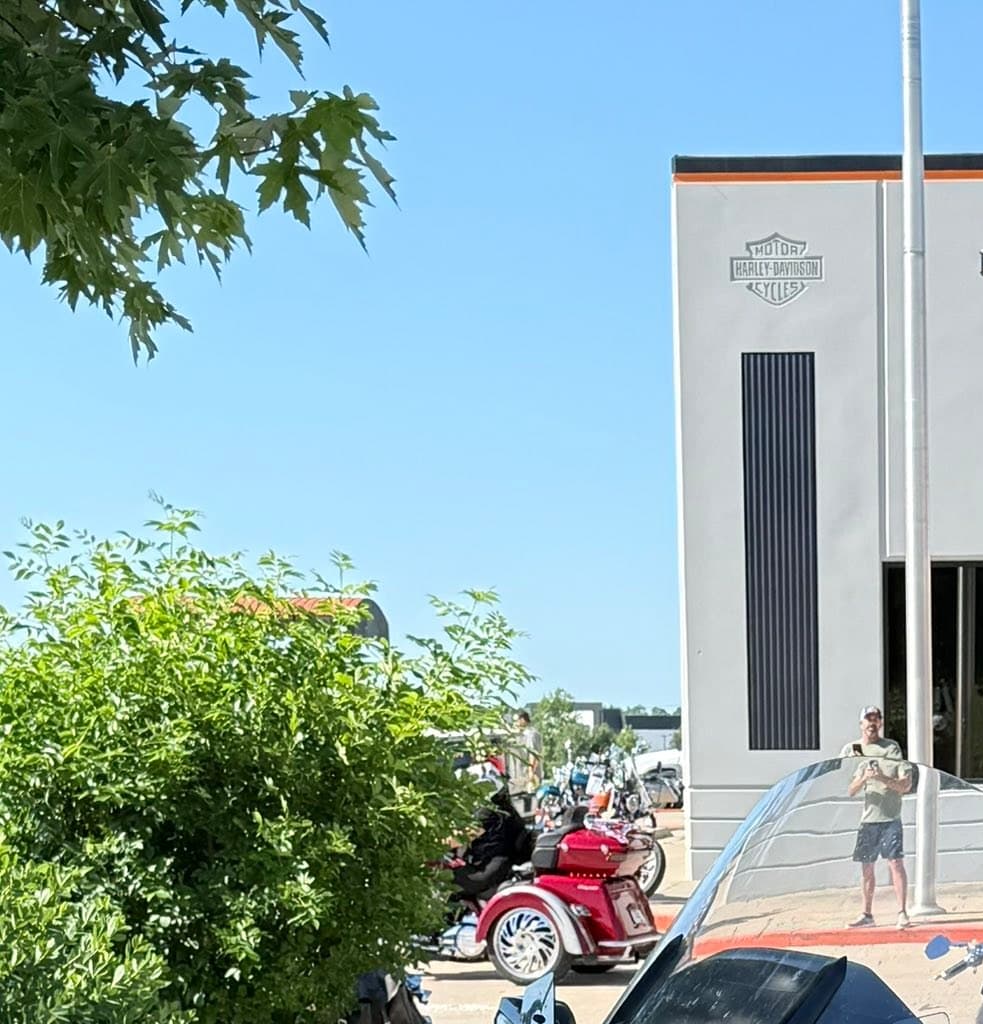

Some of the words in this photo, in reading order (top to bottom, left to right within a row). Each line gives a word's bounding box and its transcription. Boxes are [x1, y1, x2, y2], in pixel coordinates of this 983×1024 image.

[755, 239, 798, 256] MOTOR
[735, 261, 819, 277] HARLEY-DAVIDSON
[754, 282, 799, 302] CYCLES
